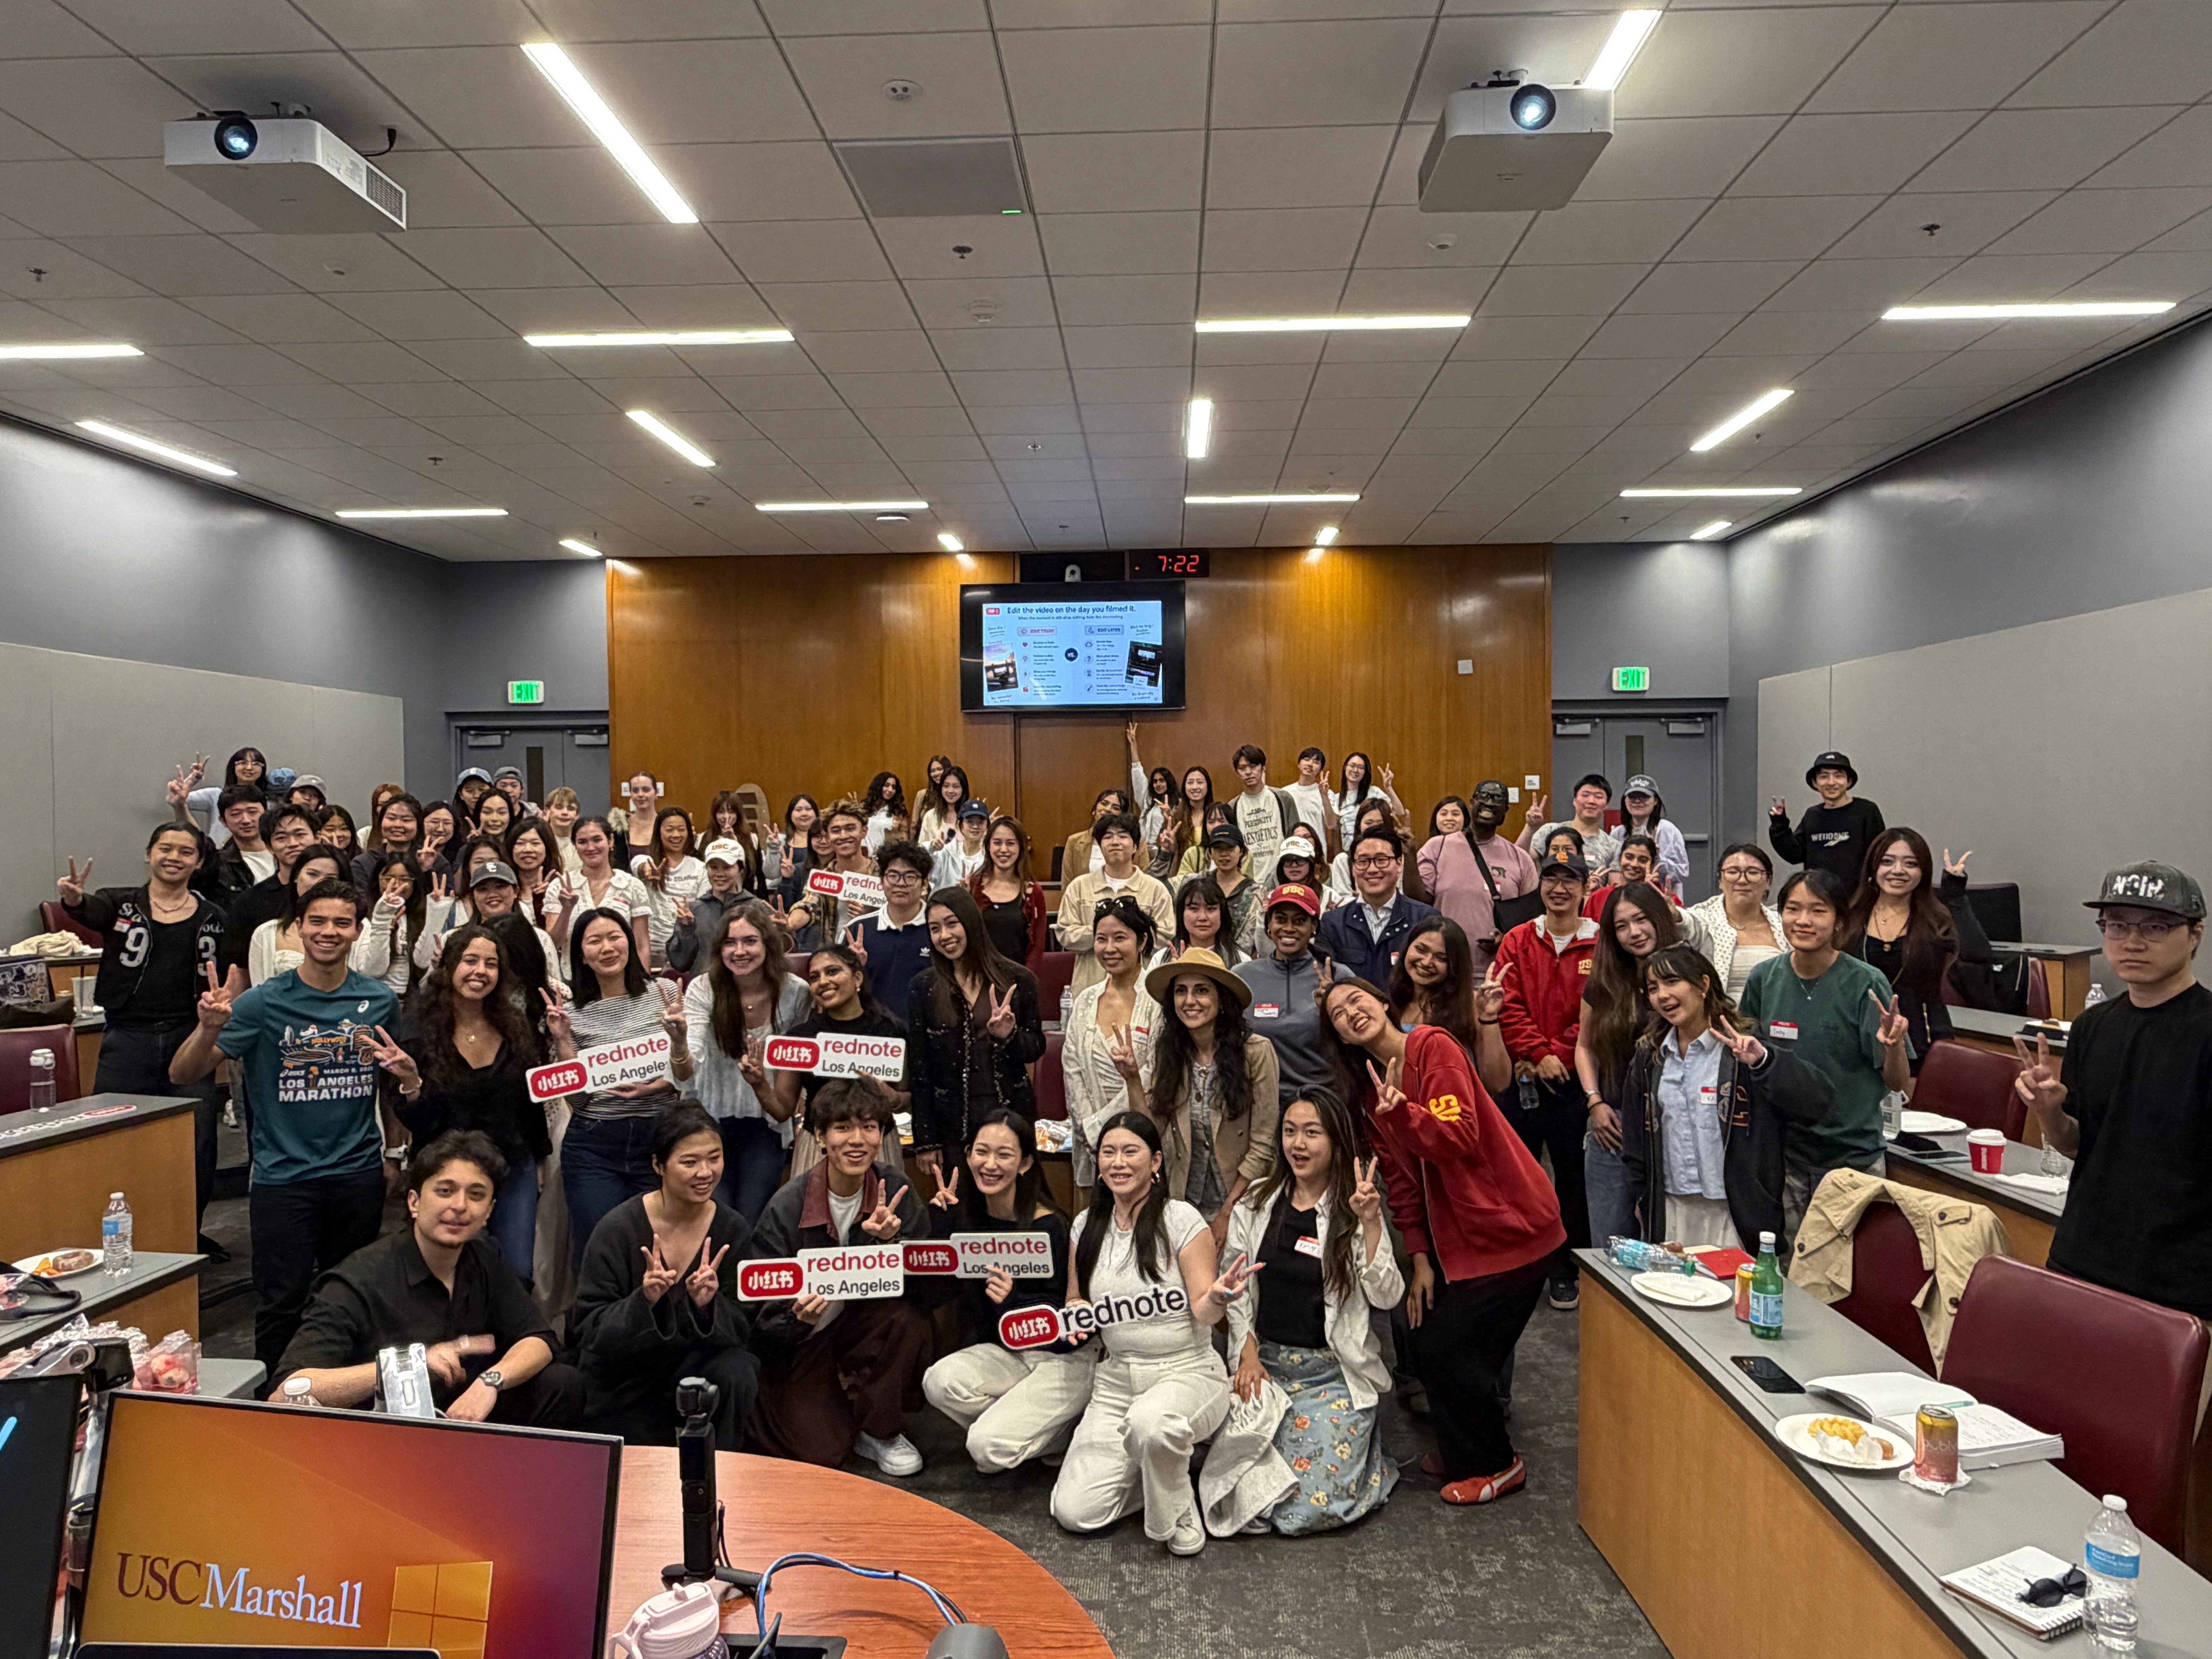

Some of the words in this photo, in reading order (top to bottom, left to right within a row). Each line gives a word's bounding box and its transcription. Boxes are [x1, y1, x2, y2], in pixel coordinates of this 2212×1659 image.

[1158, 555, 1199, 572] 7:22
[1078, 606, 1090, 614] day
[1620, 668, 1646, 690] EXIT
[514, 682, 539, 702] EXIT
[846, 876, 884, 891] redno
[1282, 885, 1304, 896] USC
[843, 889, 859, 900] Los
[119, 927, 149, 967] 9
[197, 936, 217, 977] 3
[587, 1038, 668, 1068] rednote
[773, 1045, 812, 1063] 小红书
[823, 1038, 902, 1058] rednote
[592, 1073, 617, 1087] Los
[620, 1061, 668, 1081] Angele
[822, 1060, 845, 1073] Los
[279, 1079, 305, 1089] LOS
[317, 1074, 373, 1087] ANGELES
[538, 1068, 580, 1091] 小红书
[279, 1085, 373, 1102] MARATHON
[960, 1237, 1047, 1255] rednote
[807, 1251, 900, 1273] rednote
[908, 1250, 950, 1267] 小红书
[963, 1262, 989, 1274] Los
[748, 1270, 794, 1290] 小红书
[838, 1278, 900, 1297] Angeles
[1063, 1286, 1185, 1332] rednote
[1008, 1316, 1051, 1341] 小红书
